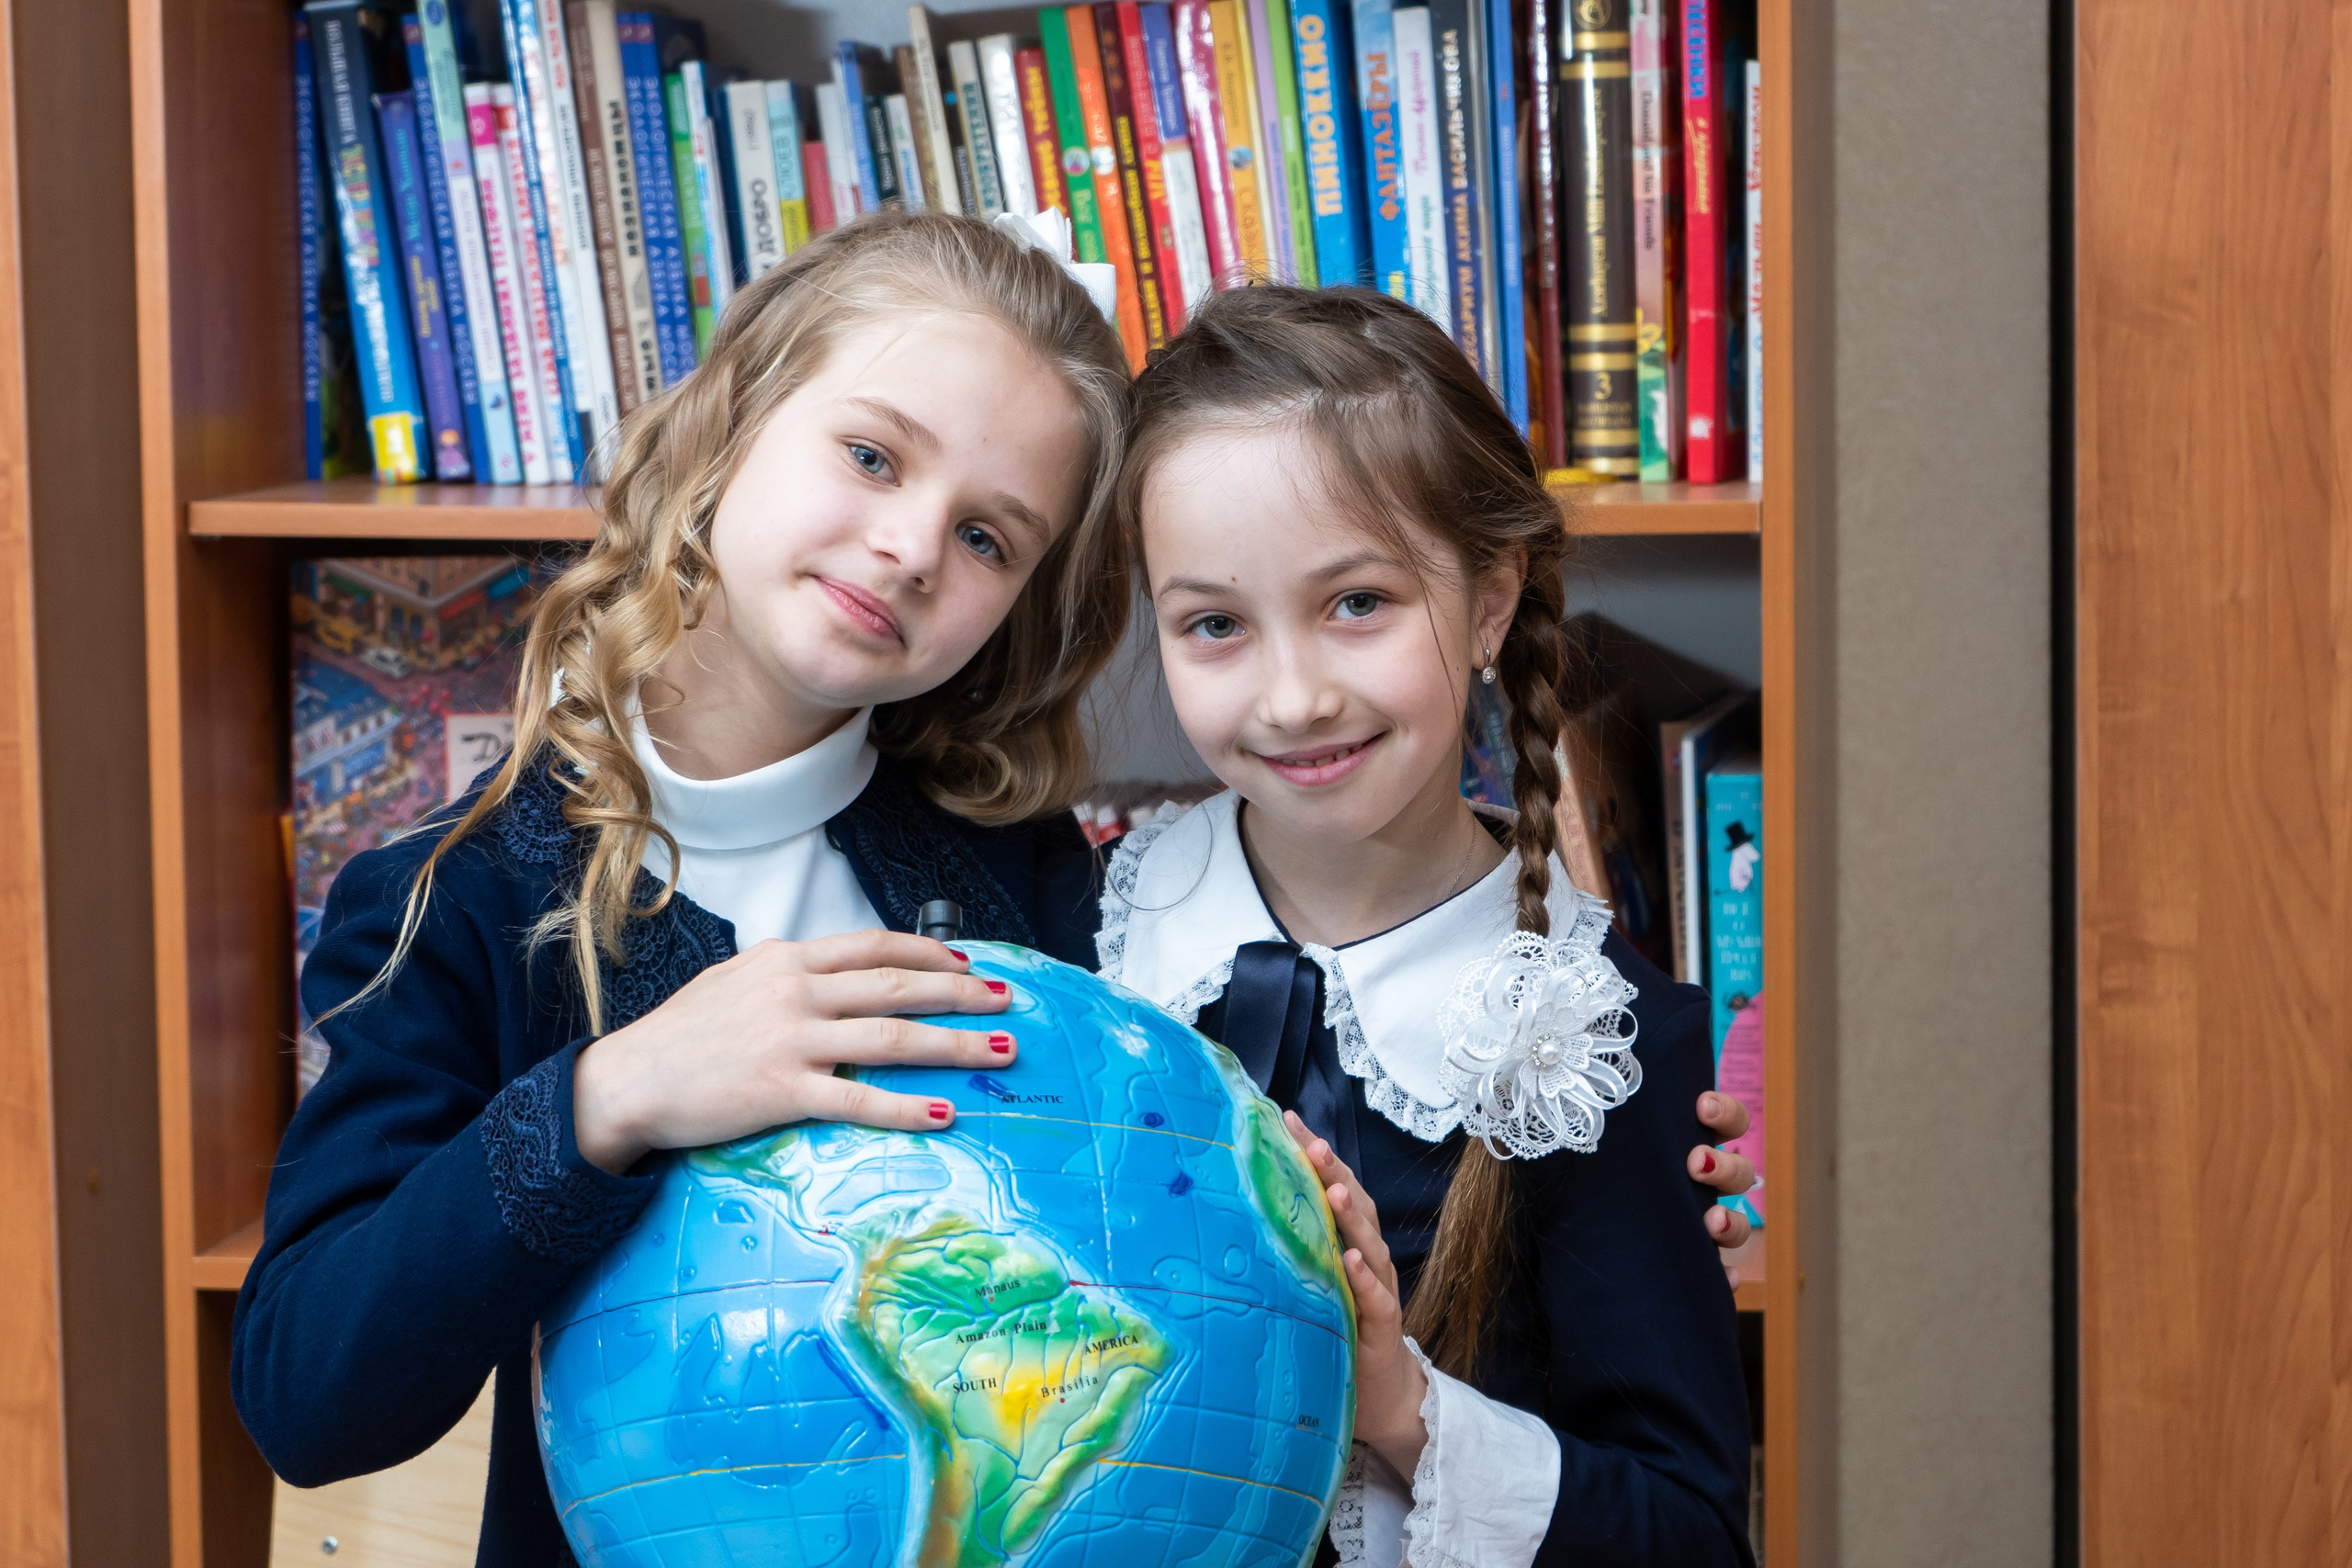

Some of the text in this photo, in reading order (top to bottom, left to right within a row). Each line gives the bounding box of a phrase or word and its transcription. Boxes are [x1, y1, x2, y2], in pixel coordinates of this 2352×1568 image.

[1299, 14, 1343, 217] ПИНОККИО
[1366, 51, 1400, 221] ФАНТАЗЁРЫ
[1443, 28, 1468, 190] ВАСИЛЬЧИКОВА
[1453, 193, 1475, 262] АКИМА
[301, 242, 317, 314] АЗБУКА
[440, 243, 465, 317] АЗБУКА
[649, 243, 667, 317] АЗБУКА
[666, 243, 685, 317] АЗБУКА
[303, 320, 320, 401] МОСКВЫ
[452, 321, 478, 405] МОСКВЫ
[1593, 371, 1612, 400] 3
[1001, 1094, 1065, 1103] ATLANTIC
[975, 1280, 1021, 1297] Manaus
[956, 1320, 1047, 1344] Amazon Plain
[1084, 1334, 1139, 1355] AMERICA
[953, 1377, 997, 1393] SOUTH
[1041, 1375, 1099, 1397] Brasilia
[1298, 1415, 1320, 1427] OCEAN
